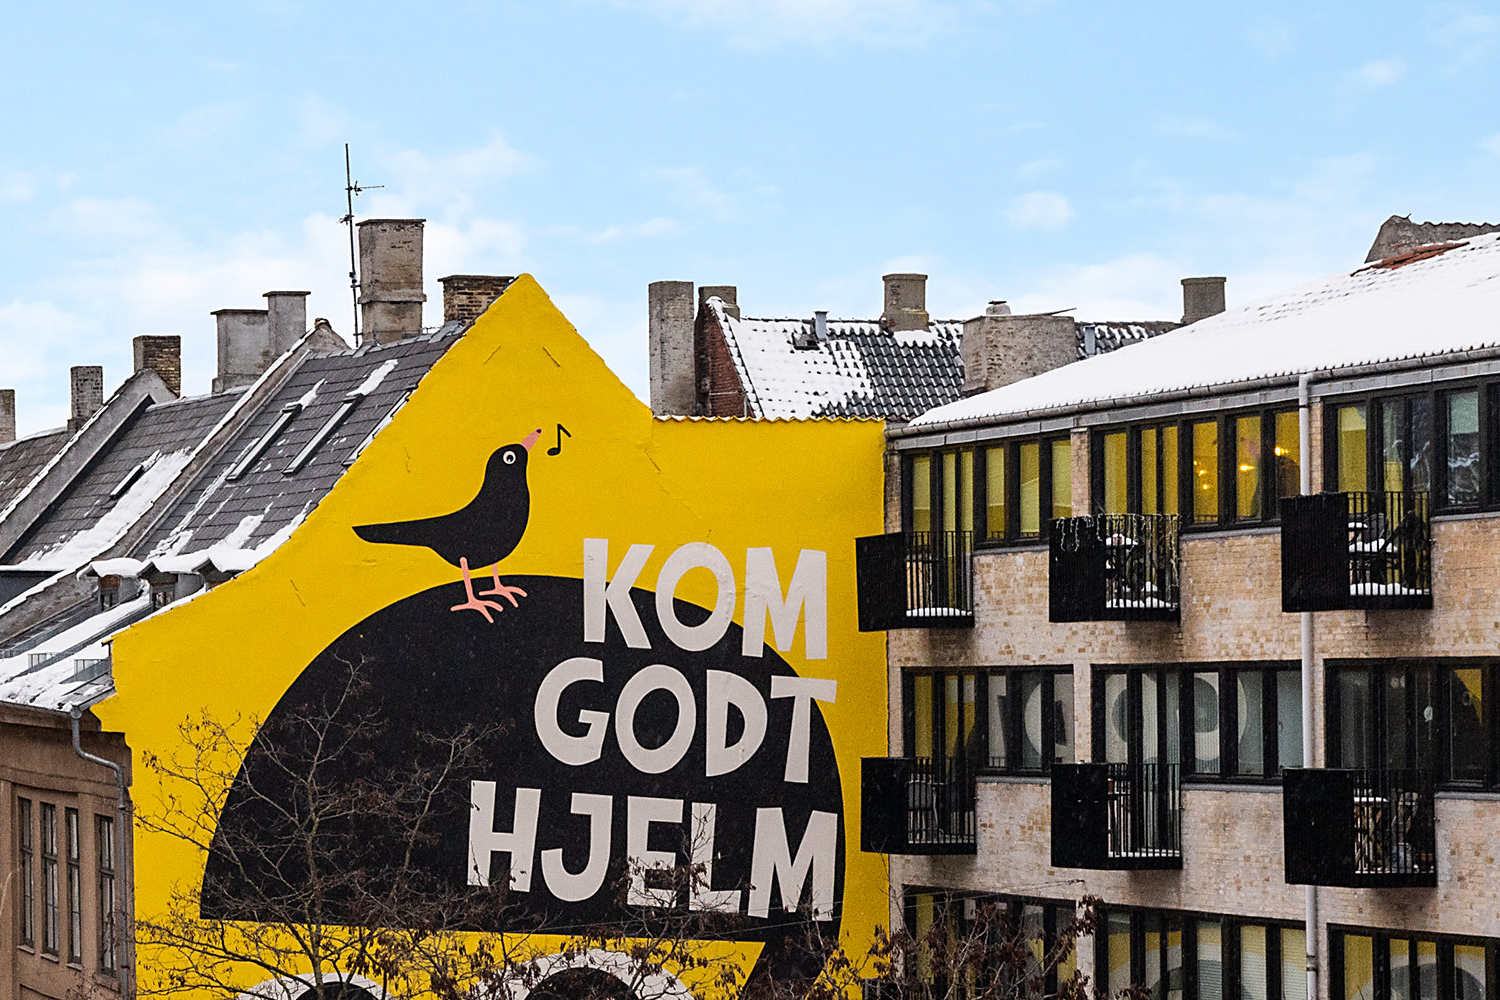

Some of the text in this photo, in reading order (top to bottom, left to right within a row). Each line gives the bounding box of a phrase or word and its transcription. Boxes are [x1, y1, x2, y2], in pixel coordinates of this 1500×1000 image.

[583, 538, 828, 660] KOM
[534, 657, 838, 784] GODT
[466, 780, 838, 922] HJELM
